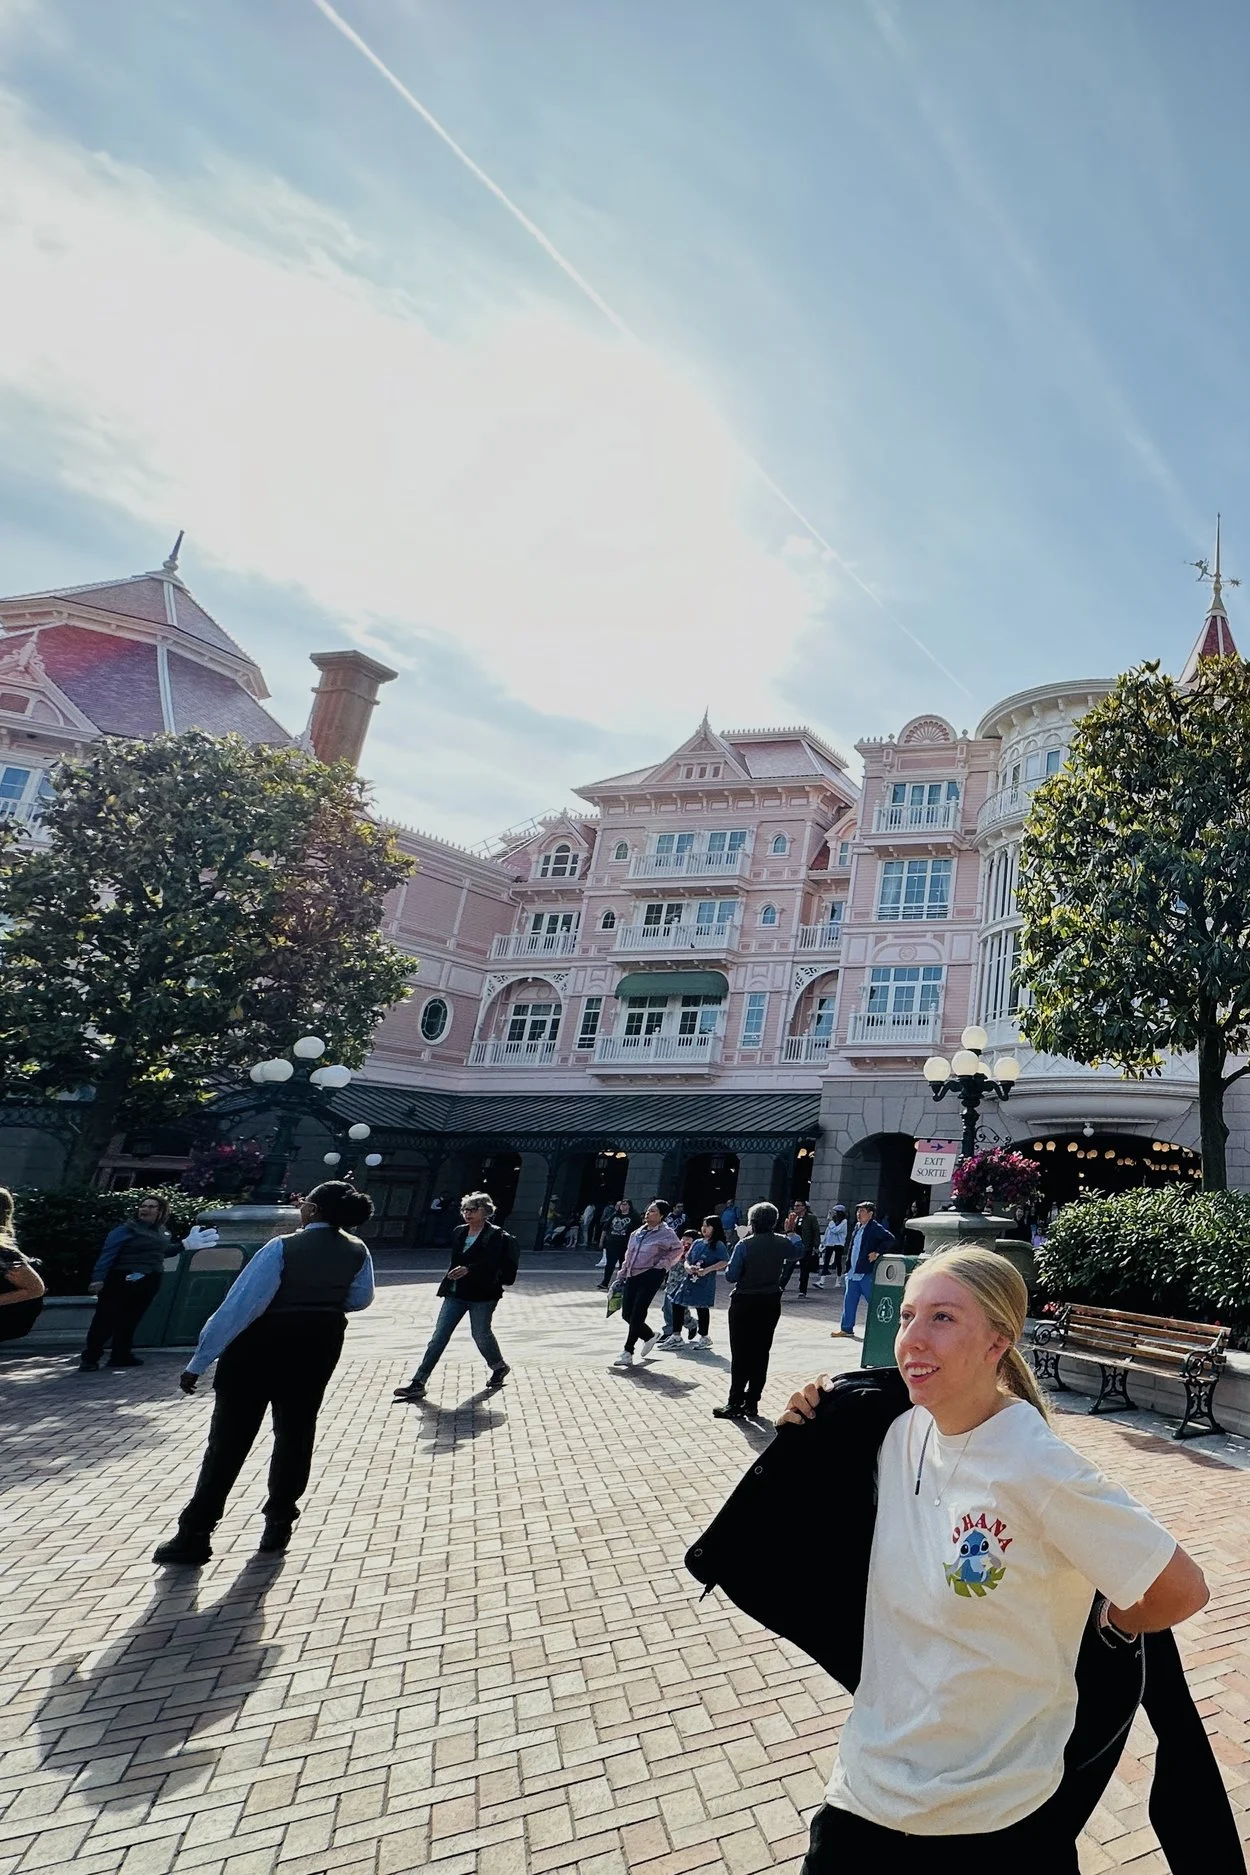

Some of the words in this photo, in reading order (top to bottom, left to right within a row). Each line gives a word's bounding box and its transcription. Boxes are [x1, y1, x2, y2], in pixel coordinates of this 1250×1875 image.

[924, 1157, 945, 1166] EXIT
[916, 1168, 948, 1177] SORTIE
[951, 1512, 1013, 1553] OHANA
